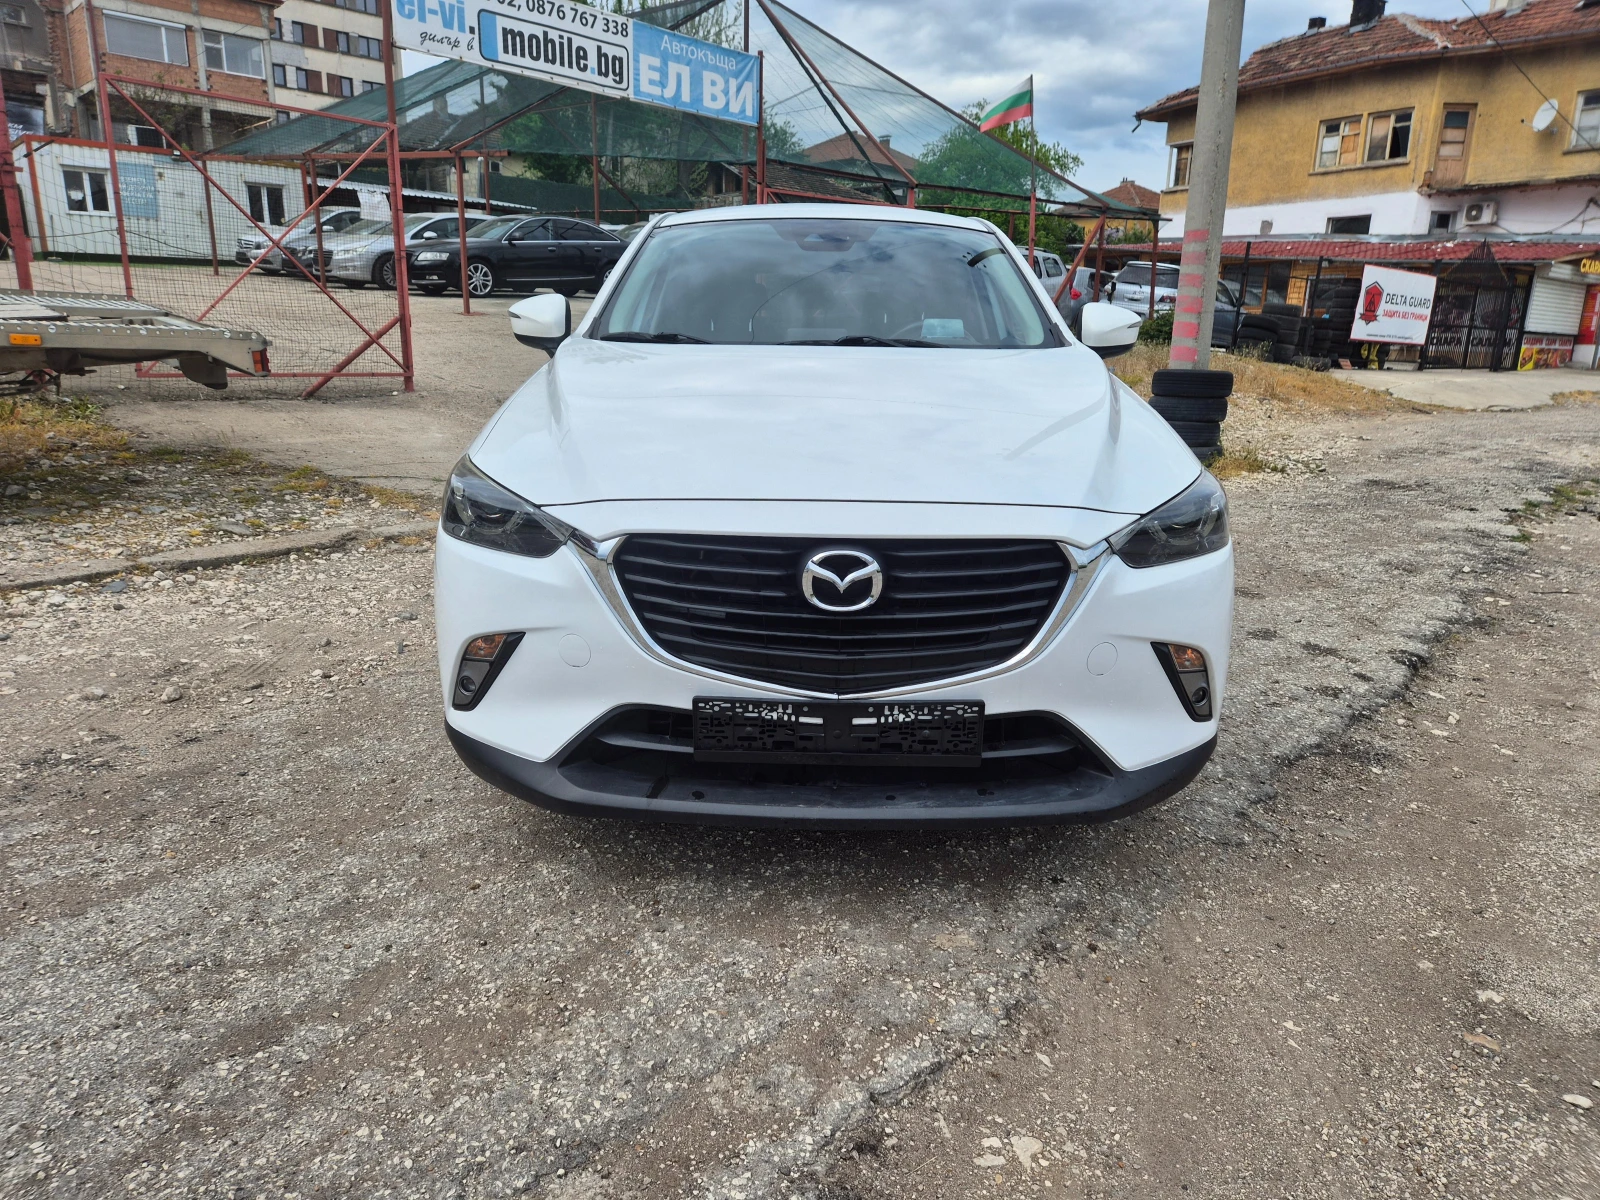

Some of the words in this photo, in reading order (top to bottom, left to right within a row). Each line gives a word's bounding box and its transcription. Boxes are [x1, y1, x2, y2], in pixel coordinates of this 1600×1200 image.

[526, 0, 566, 20] 0876
[570, 7, 597, 29] 767
[602, 17, 629, 37] 338
[419, 31, 461, 51] дилър
[467, 37, 475, 51] в
[502, 26, 624, 85] mobile.bg
[661, 35, 736, 71] Автокъща
[639, 53, 691, 103] ЕЛ
[702, 70, 753, 117] ВИ
[1385, 293, 1407, 307] DELTA
[1408, 296, 1431, 309] GUARD
